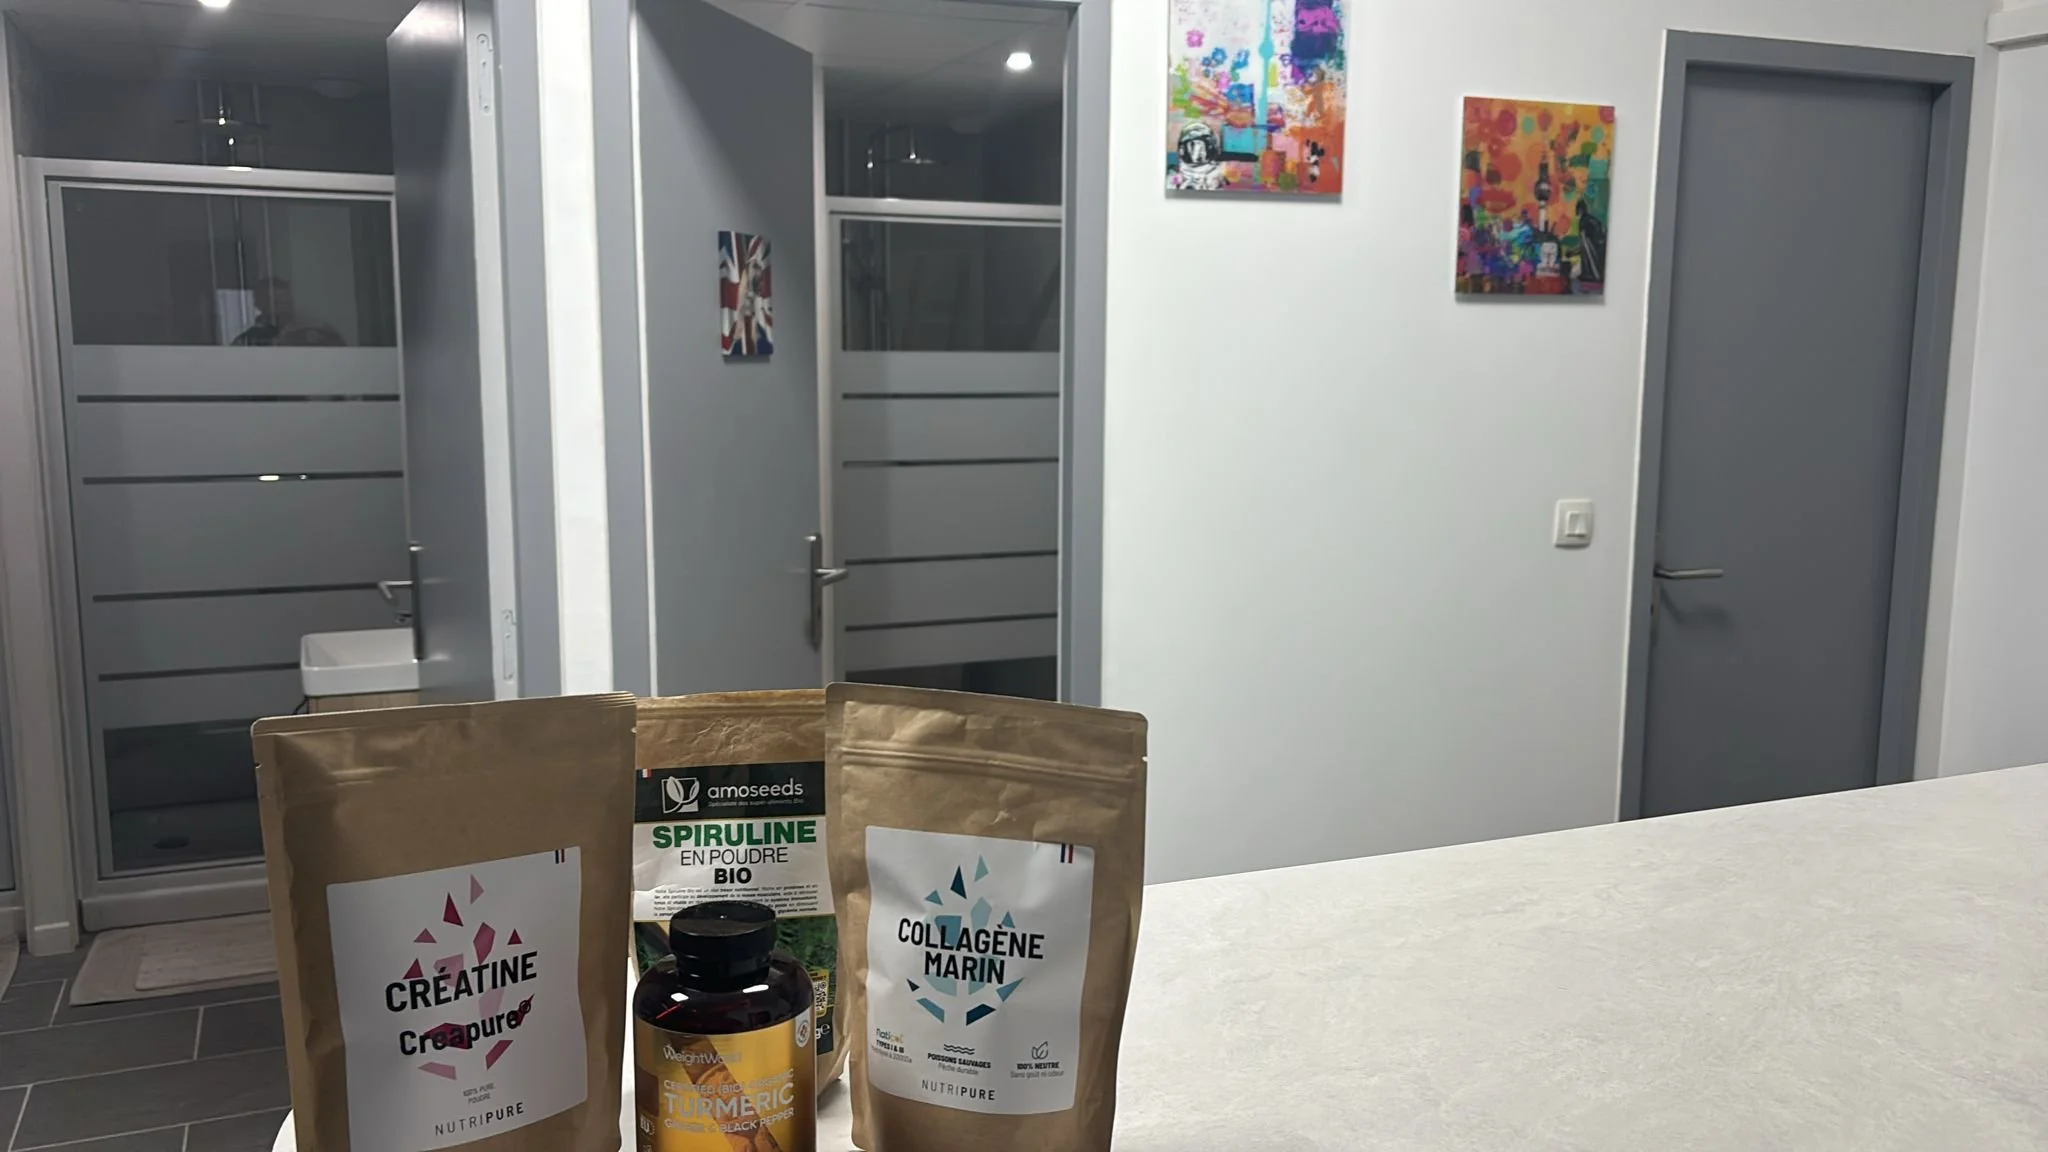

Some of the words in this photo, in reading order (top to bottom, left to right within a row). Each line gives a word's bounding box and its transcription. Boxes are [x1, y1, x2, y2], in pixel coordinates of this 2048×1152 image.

[707, 777, 804, 799] amoseeds
[652, 820, 817, 849] SPIRULINE
[680, 850, 704, 866] EN
[709, 847, 789, 864] POUDRE
[714, 867, 752, 885] BIO
[897, 918, 1045, 960] COLLAGÈNE
[924, 951, 1005, 985] MARIN
[385, 951, 538, 1013] CRÉATINE
[663, 1042, 741, 1066] WeightWo
[664, 1083, 794, 1118] TURMERIC
[921, 1079, 996, 1100] NUTRIPURE
[434, 1102, 524, 1136] NUTRIPURE
[720, 1120, 757, 1133] BLACK
[759, 1107, 794, 1127] PEPPER
